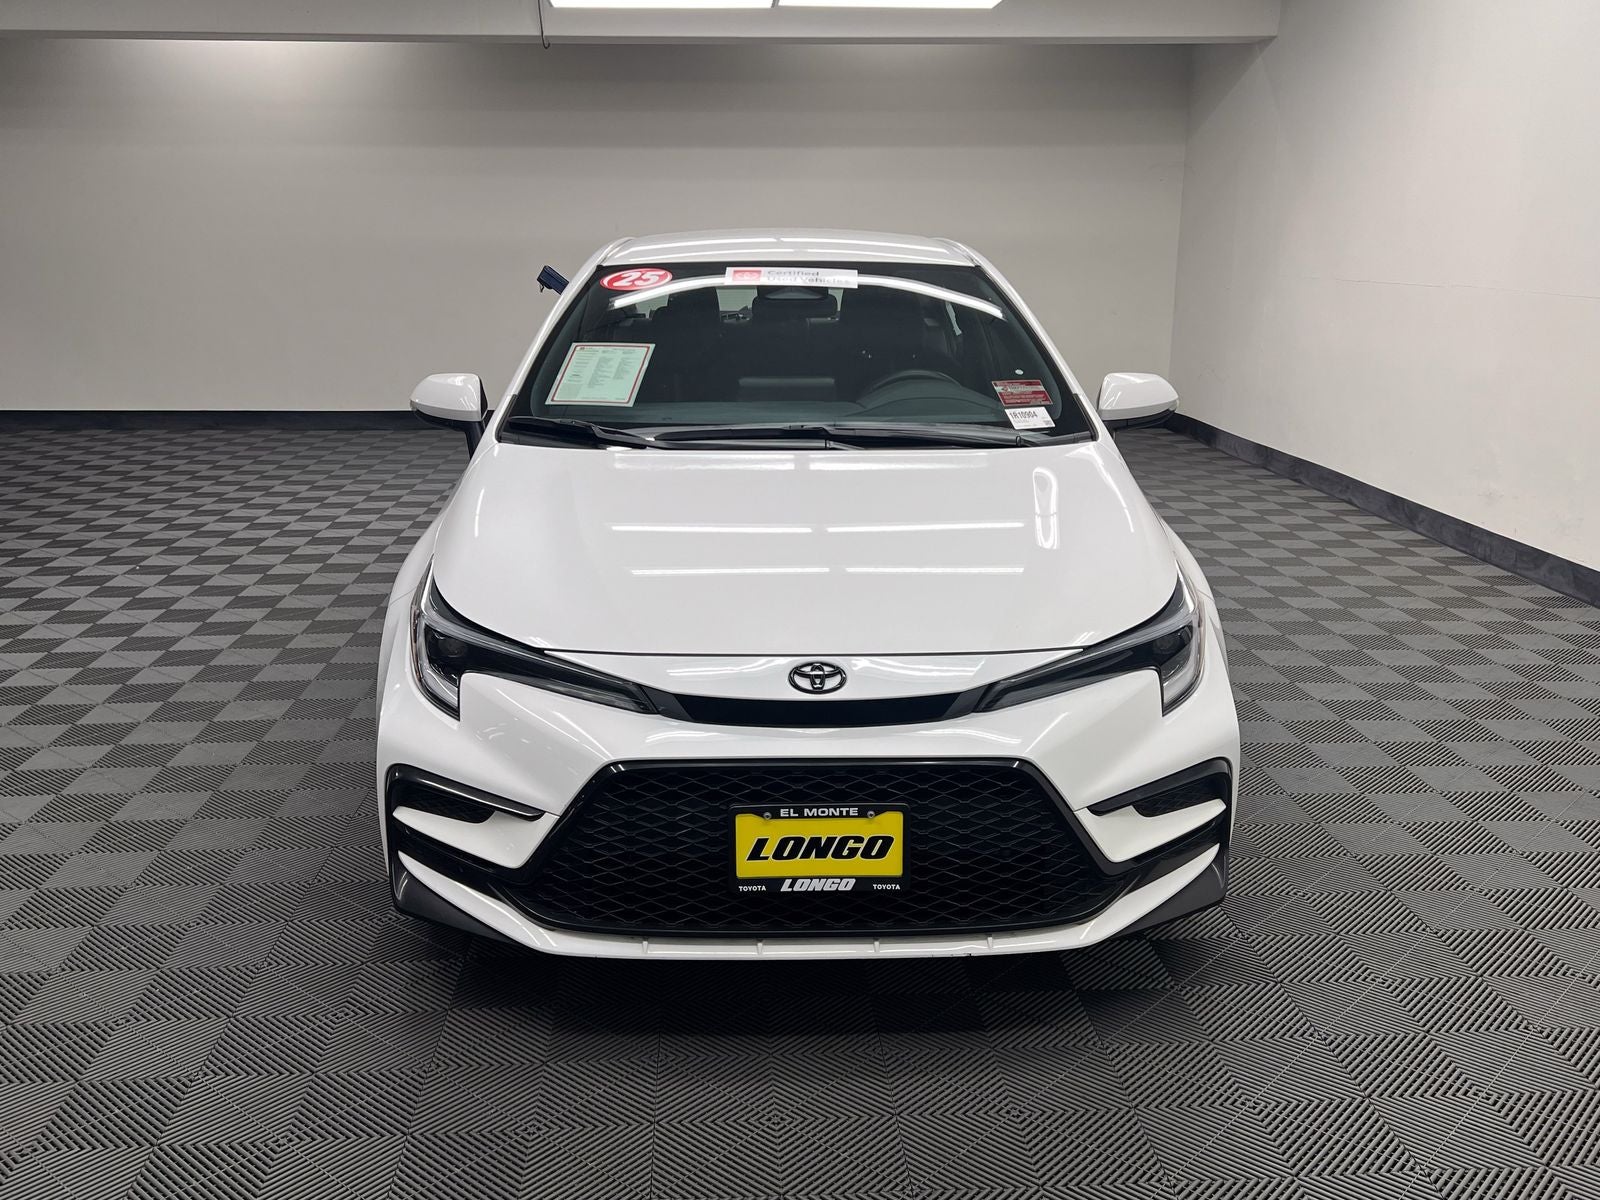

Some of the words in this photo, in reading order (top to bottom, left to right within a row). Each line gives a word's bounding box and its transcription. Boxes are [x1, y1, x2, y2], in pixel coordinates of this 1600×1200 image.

[613, 271, 664, 287] 25
[780, 808, 799, 817] EL
[804, 807, 859, 817] MONTE
[746, 835, 895, 861] LONGO
[780, 878, 857, 892] LONGO
